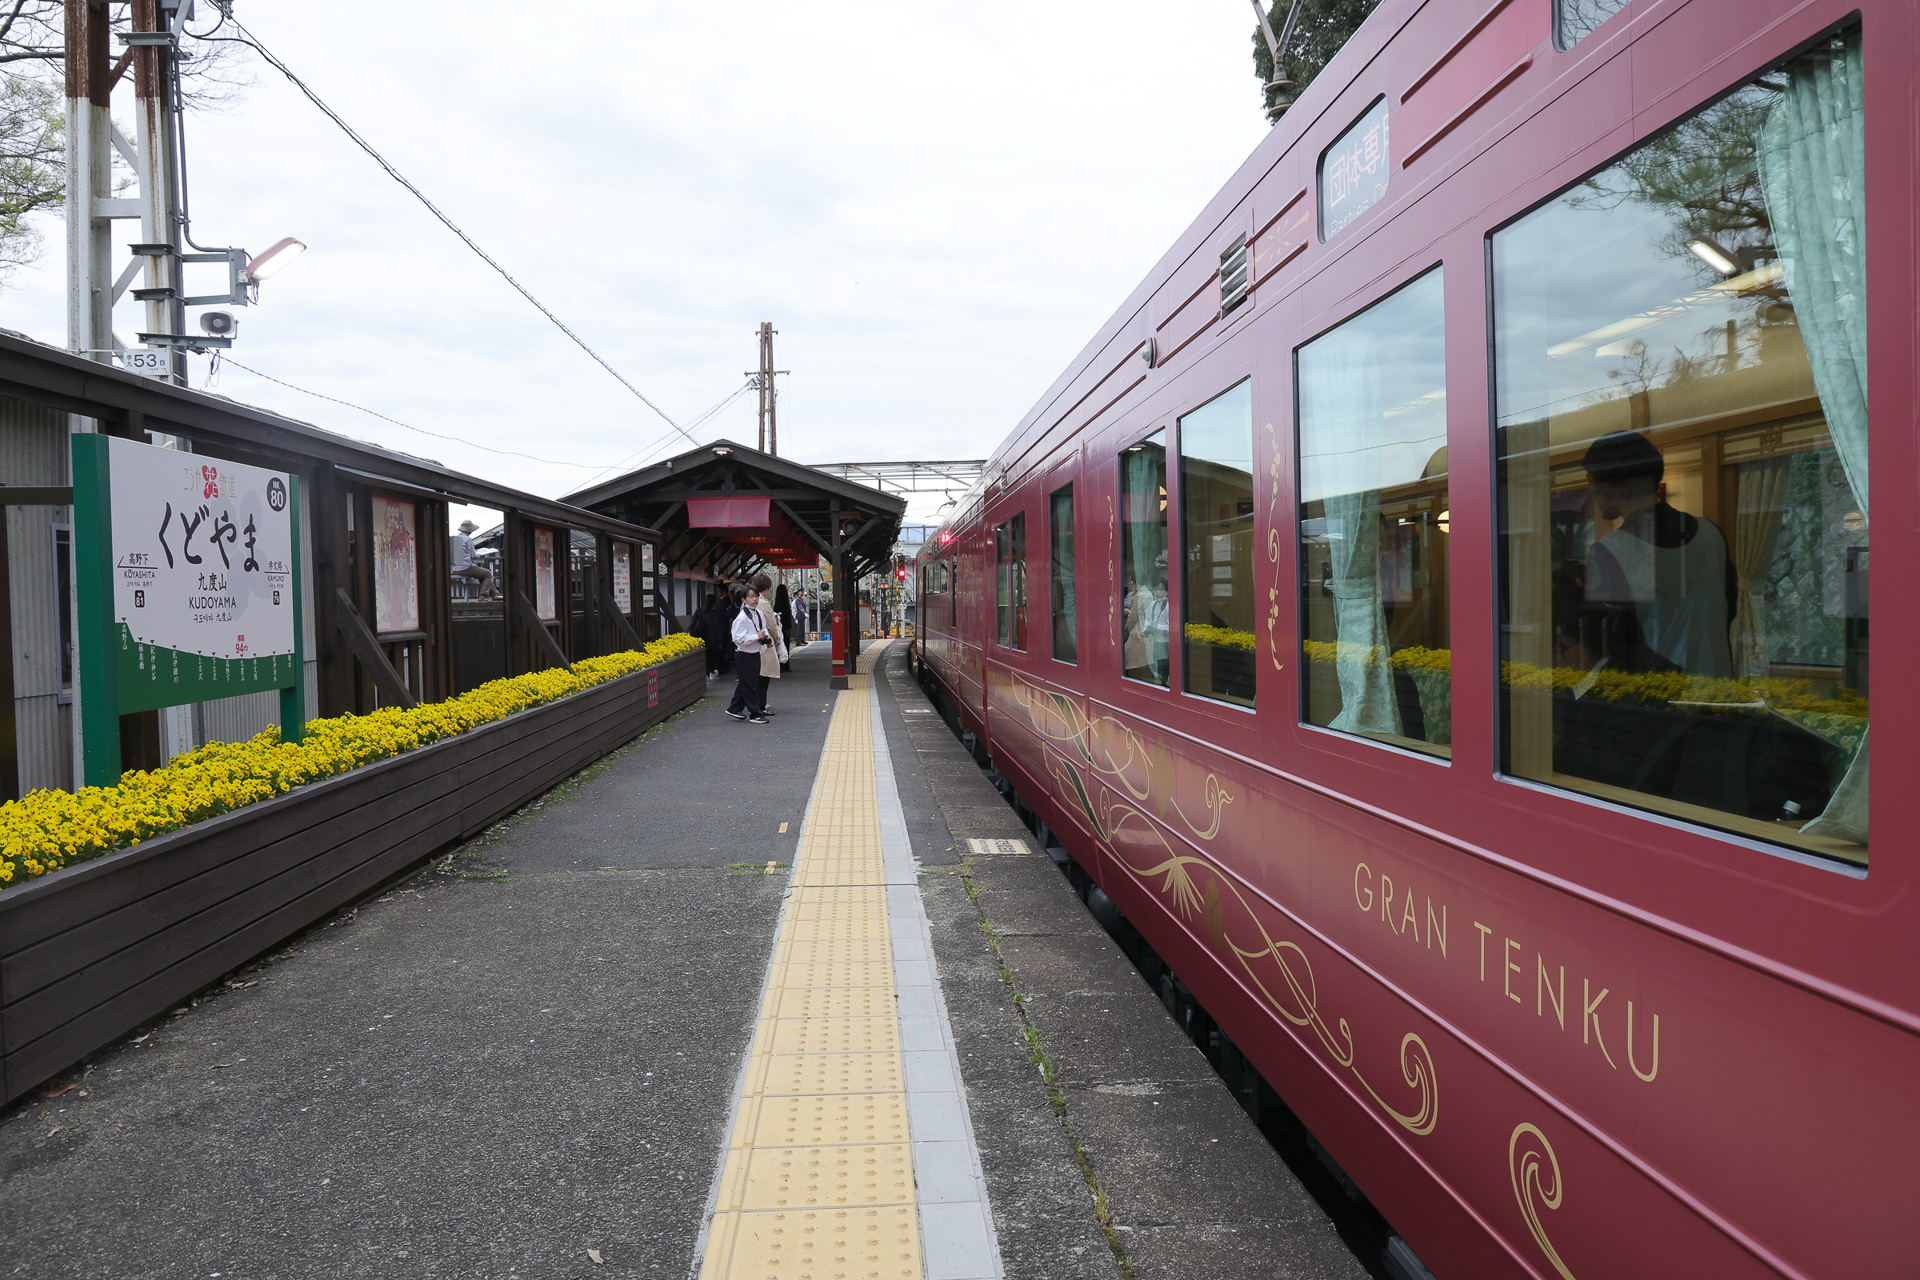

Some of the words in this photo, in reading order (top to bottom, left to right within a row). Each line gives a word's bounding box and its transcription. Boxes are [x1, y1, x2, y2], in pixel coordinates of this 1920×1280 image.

[134, 353, 157, 367] 53
[272, 481, 281, 489] NK
[270, 489, 284, 508] 80
[158, 501, 260, 572] くどやま
[128, 552, 149, 565] 高野下
[197, 572, 227, 591] 九度山
[188, 596, 237, 609] KUDOYAMA
[216, 611, 232, 622] 九度山
[235, 643, 249, 654] 94m
[1354, 862, 1447, 960] GRAN
[1473, 920, 1659, 1083] TENKU
